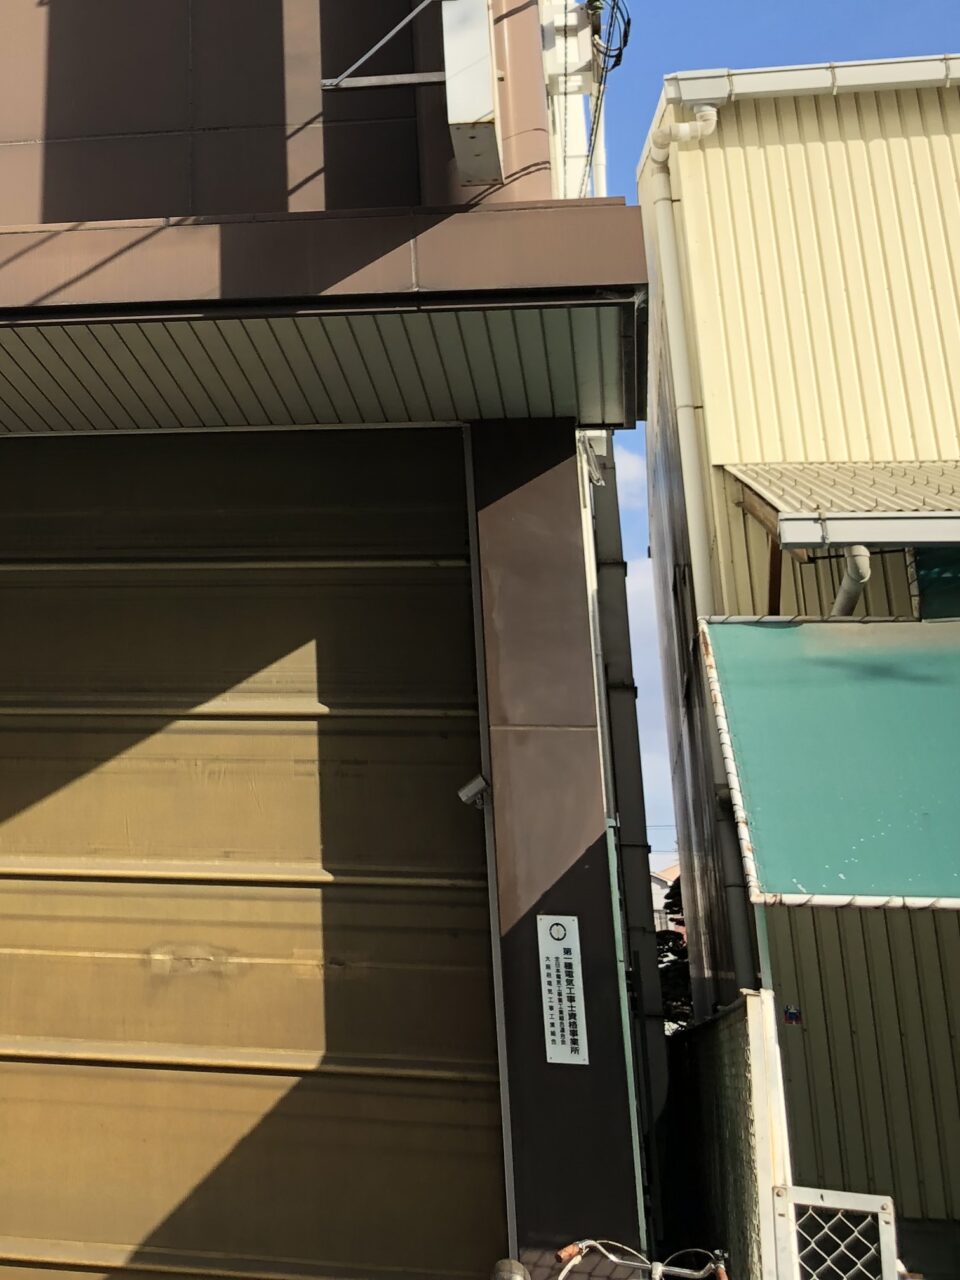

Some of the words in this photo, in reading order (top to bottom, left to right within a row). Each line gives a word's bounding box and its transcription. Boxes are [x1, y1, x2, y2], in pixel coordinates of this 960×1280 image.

[563, 947, 580, 1055] 第一種電気工事士資格事業所
